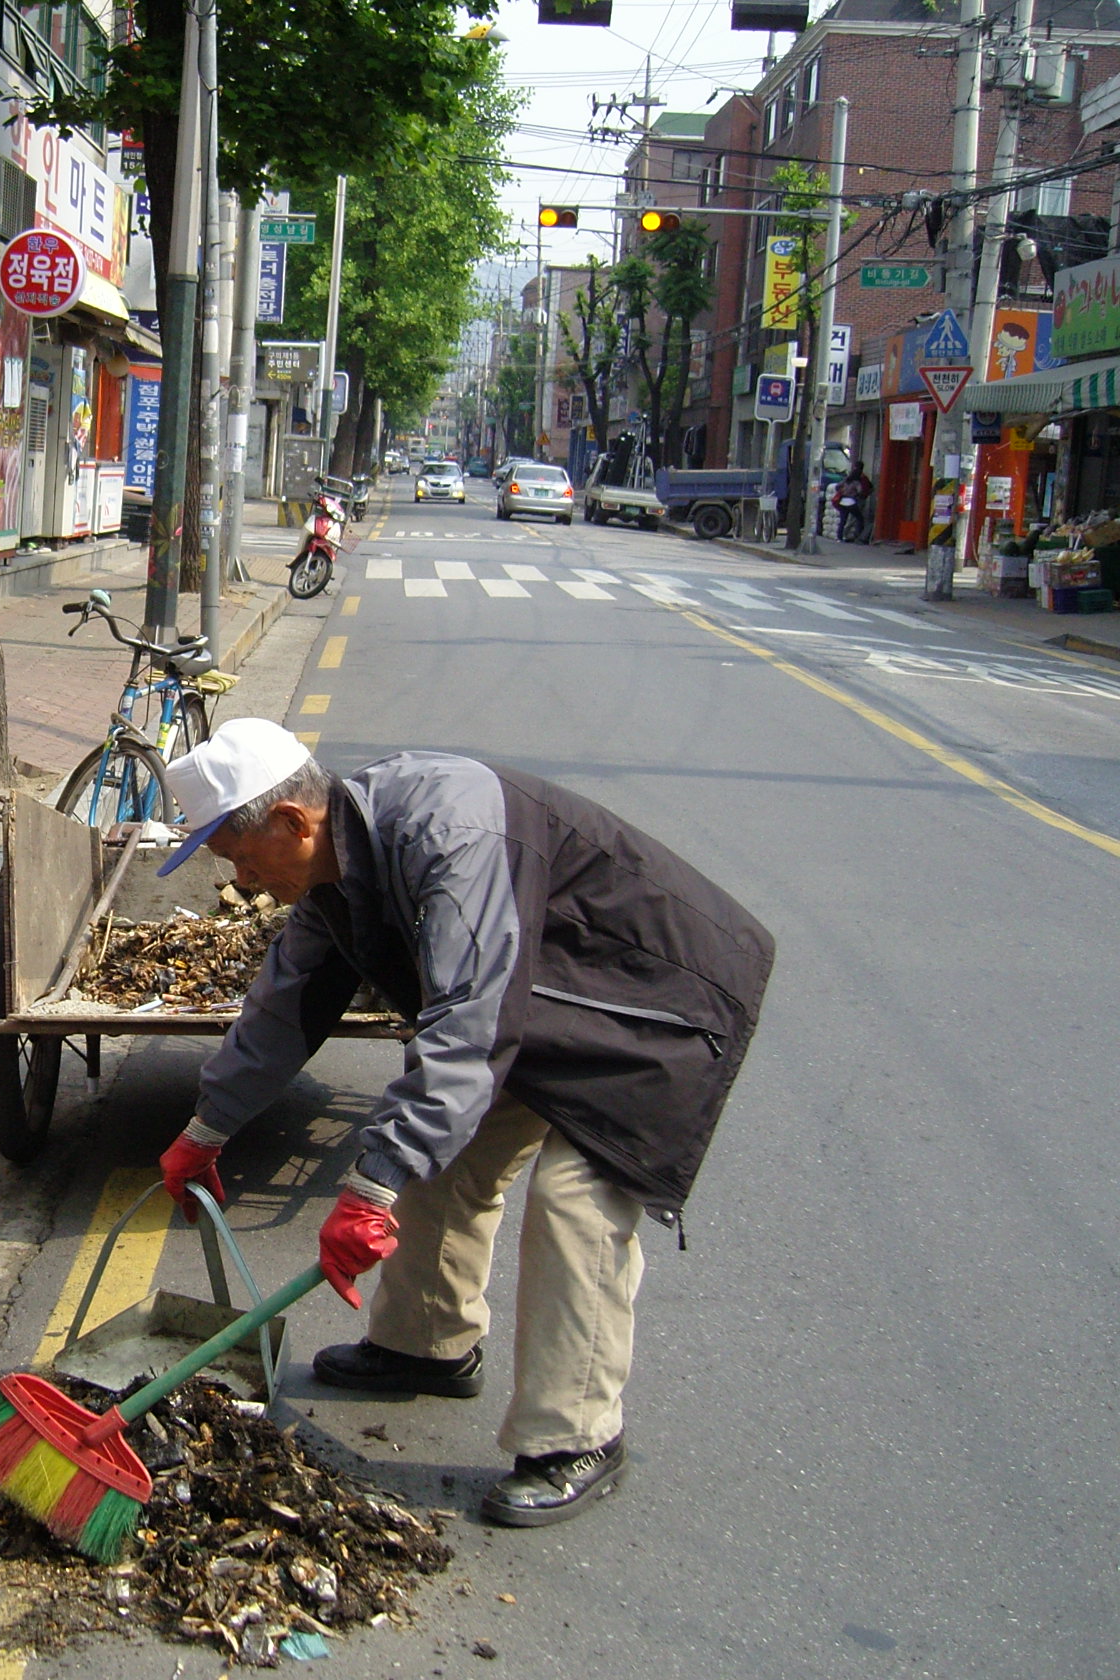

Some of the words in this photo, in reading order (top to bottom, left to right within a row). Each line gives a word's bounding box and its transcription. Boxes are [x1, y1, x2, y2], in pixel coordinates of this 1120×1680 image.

[7, 253, 76, 294] 정육점
[771, 260, 794, 325] 부동산
[932, 372, 960, 385] 천천히
[936, 384, 956, 392] SLOW
